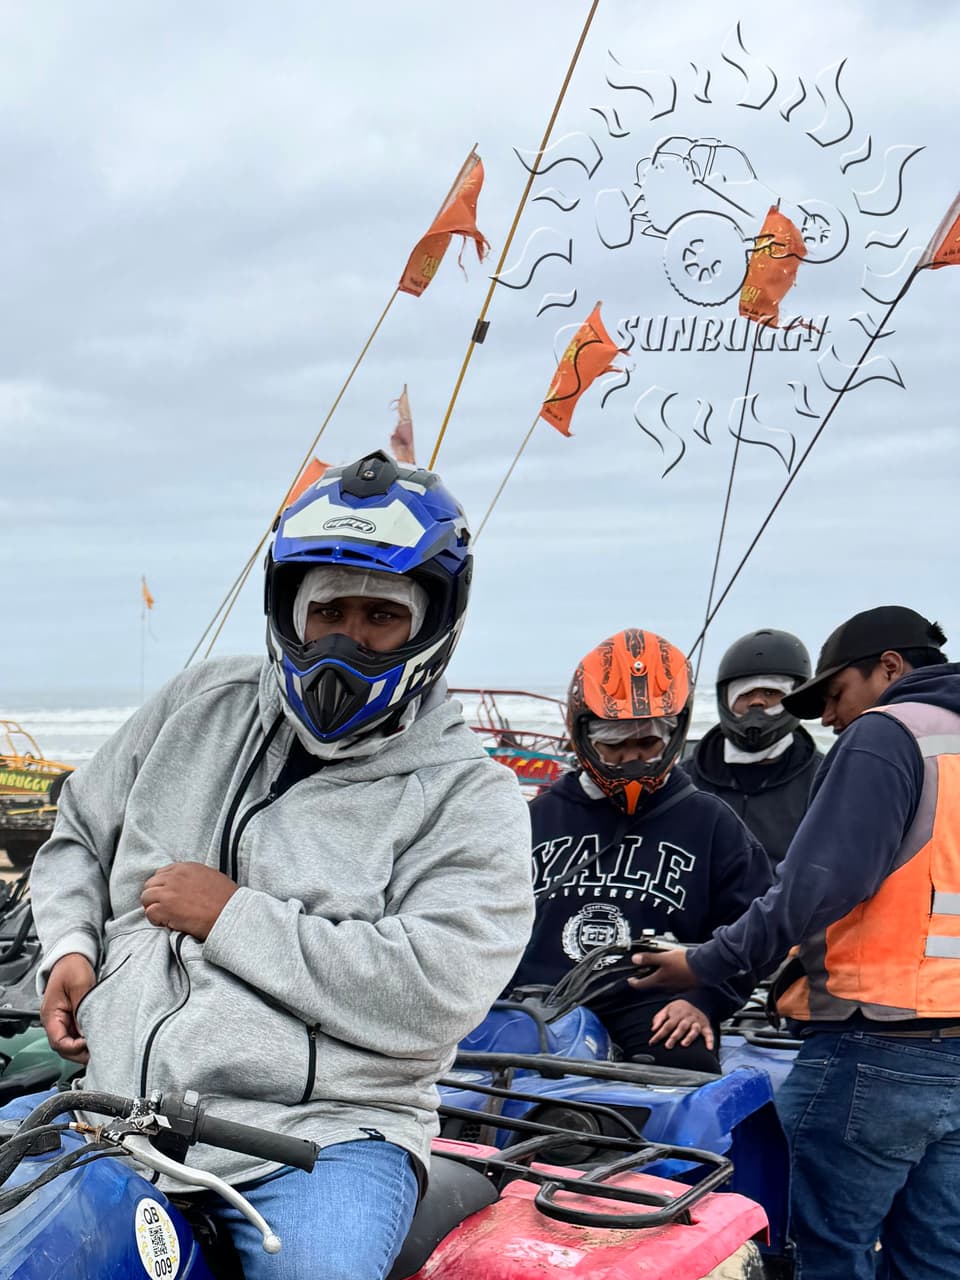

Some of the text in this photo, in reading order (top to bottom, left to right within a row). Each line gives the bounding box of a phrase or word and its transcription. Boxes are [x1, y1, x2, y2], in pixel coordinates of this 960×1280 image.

[532, 834, 696, 909] YALE
[536, 886, 675, 915] IVERSITY
[143, 1206, 160, 1225] QB
[154, 1257, 173, 1278] 009
